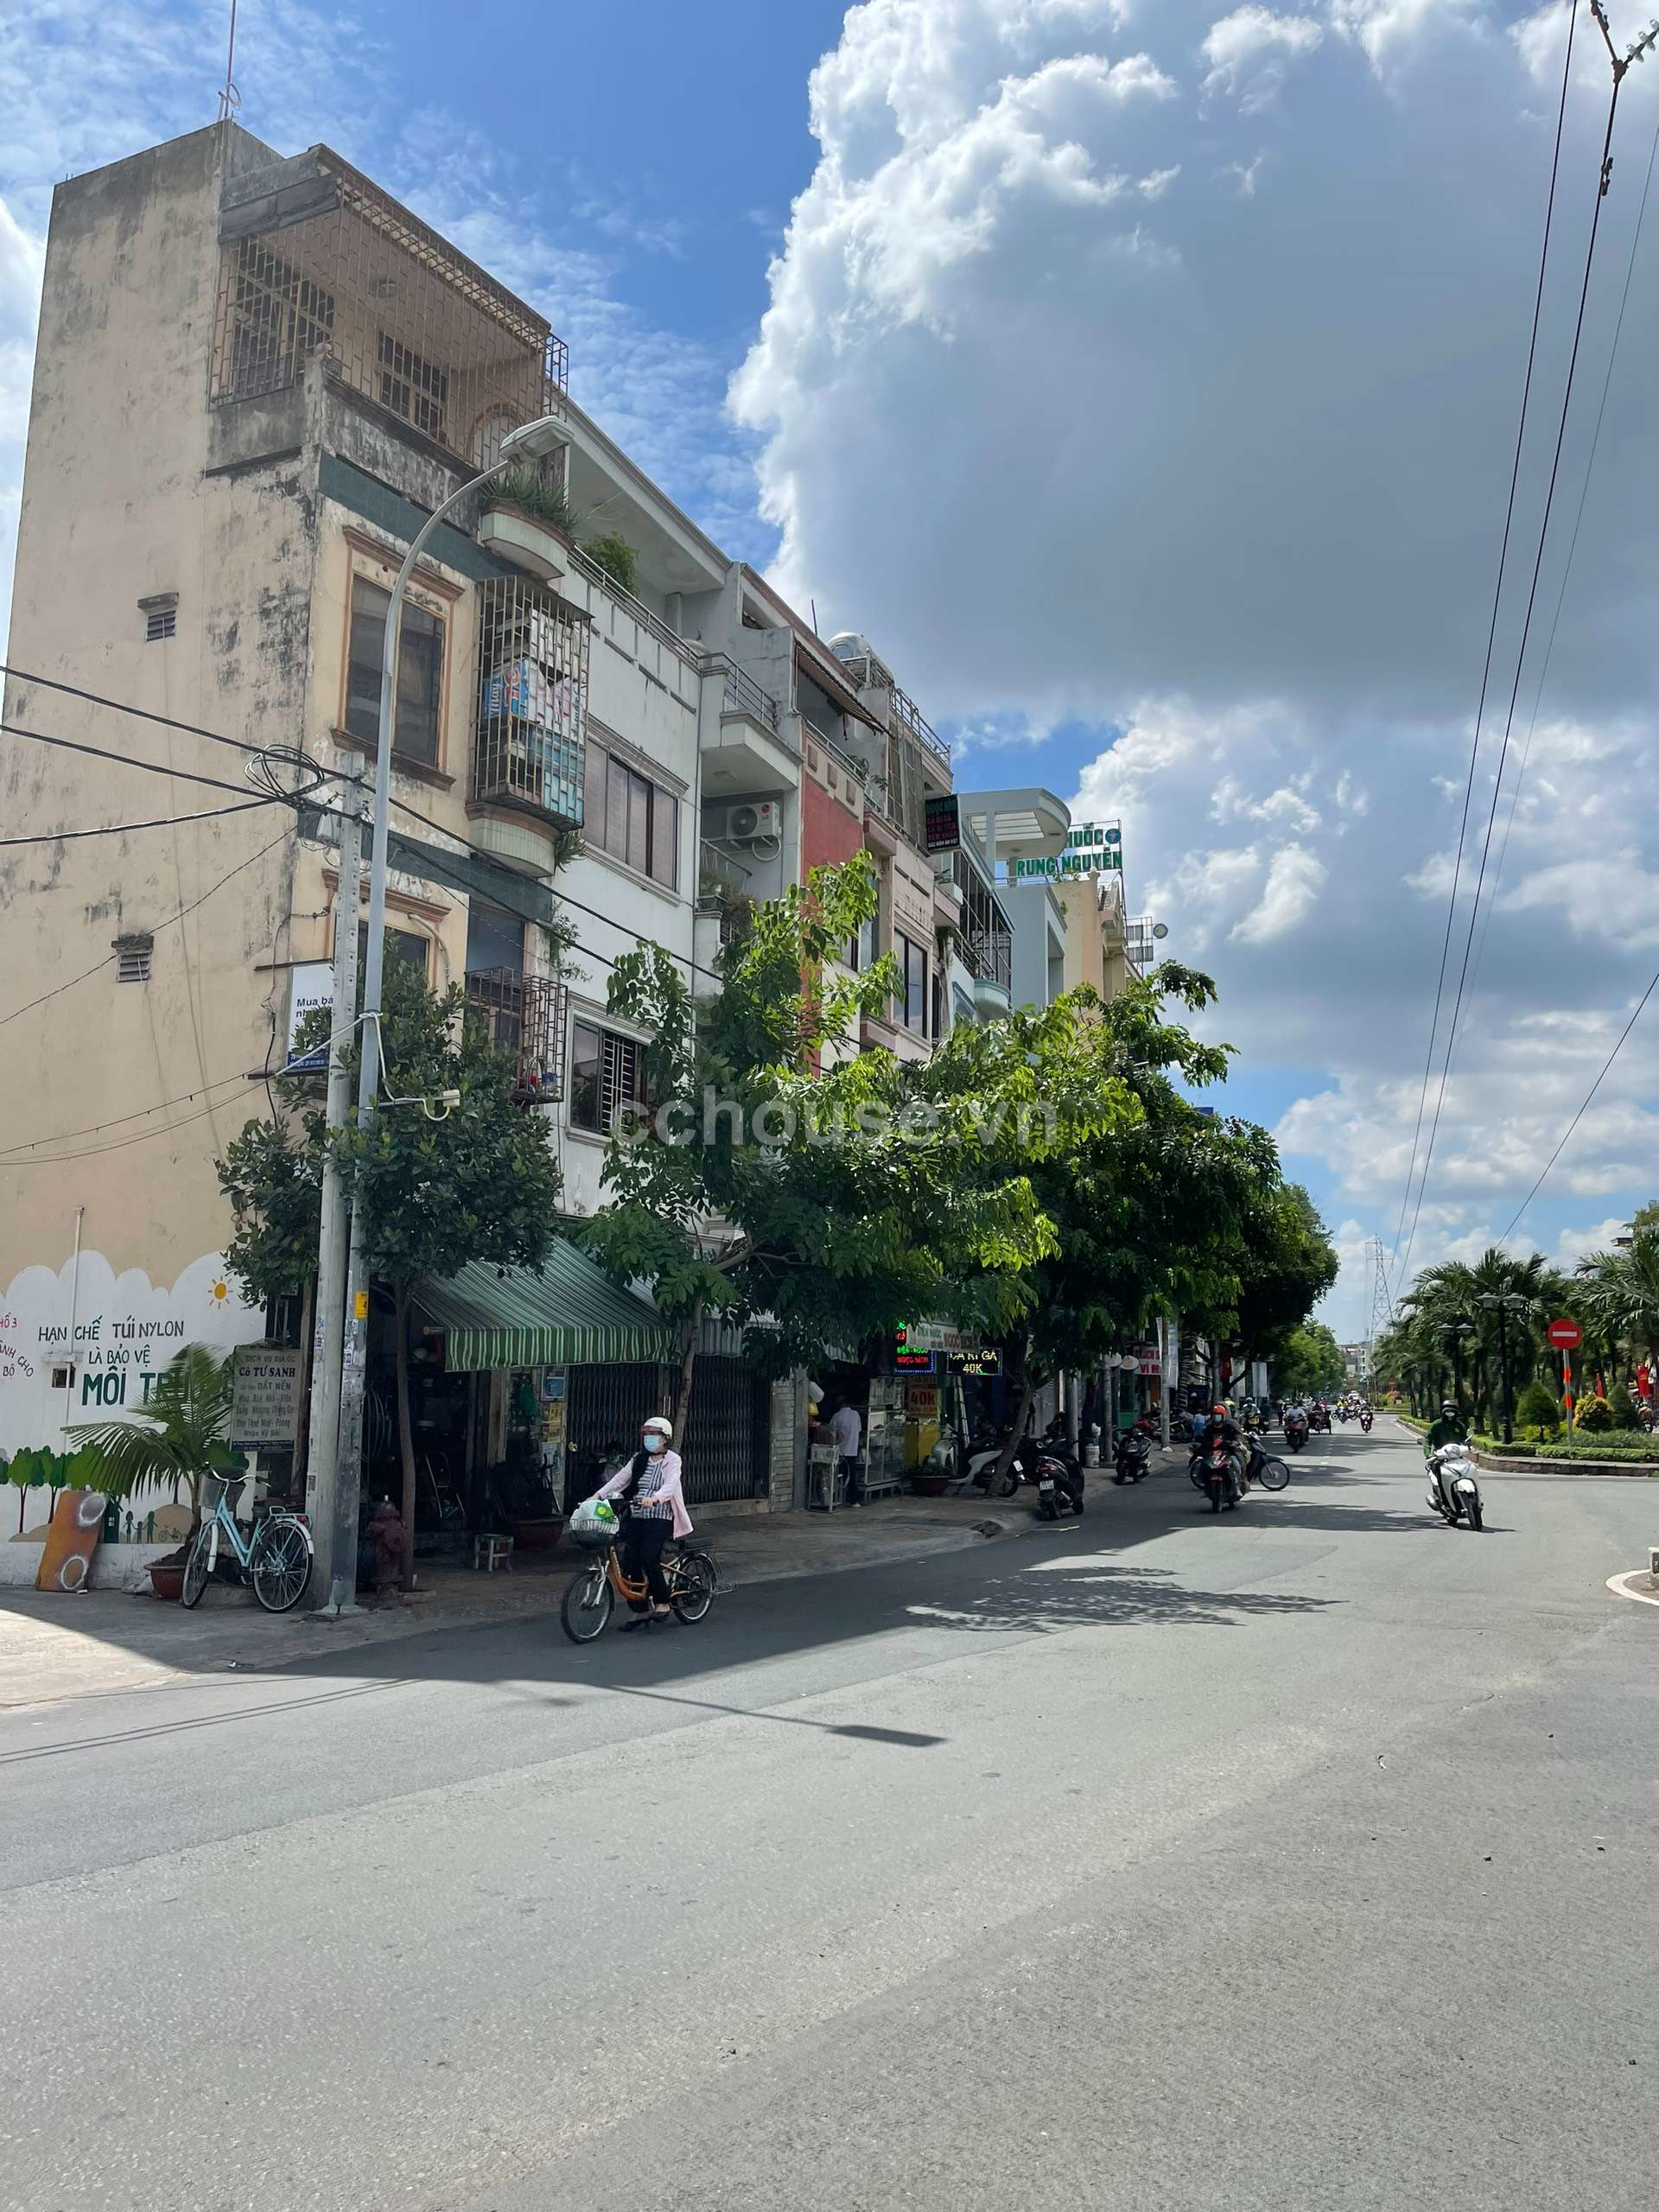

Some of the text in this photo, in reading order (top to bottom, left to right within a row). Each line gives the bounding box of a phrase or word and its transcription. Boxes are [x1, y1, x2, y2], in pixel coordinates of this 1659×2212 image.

[296, 995, 334, 1007] Mua bá
[12, 1318, 17, 1328] 3
[39, 1326, 67, 1345] HẠN
[74, 1315, 103, 1340] CHẾ
[138, 1320, 184, 1338] NYLON
[89, 1343, 150, 1367] LÀ BẢO VỆ
[17, 1356, 34, 1377] CHO
[269, 1367, 296, 1377] SANH
[963, 1363, 982, 1373] 40K
